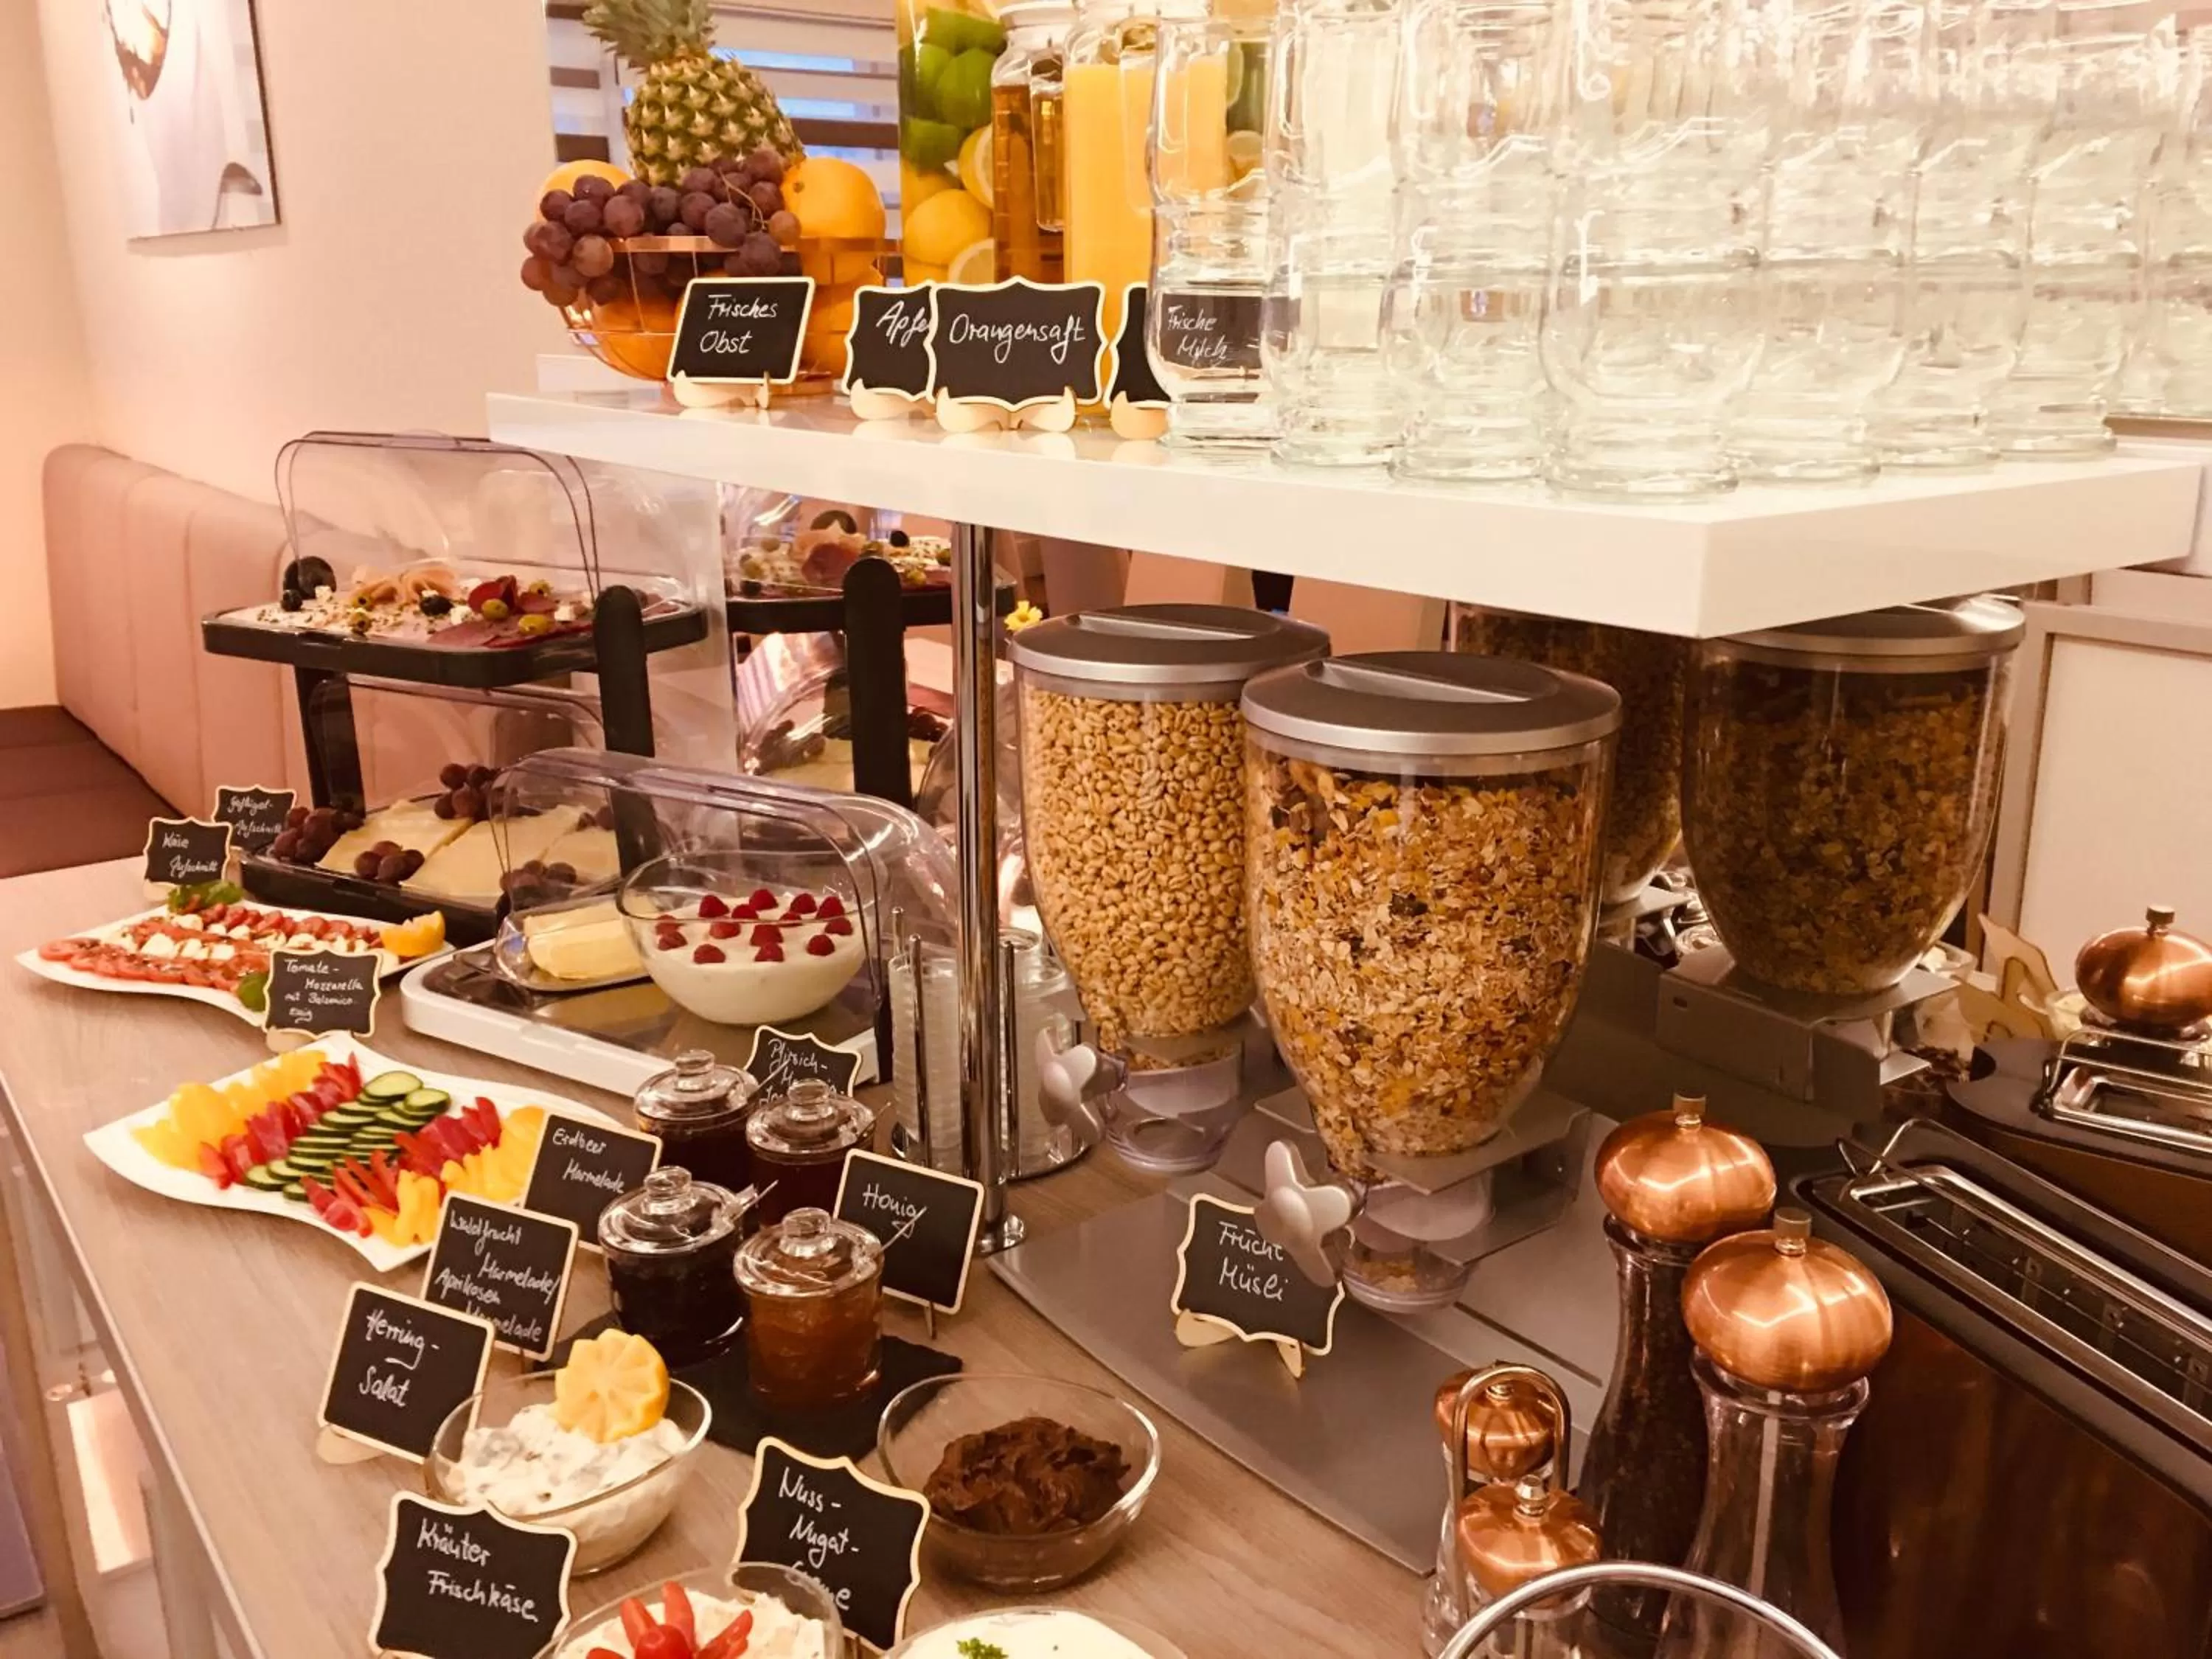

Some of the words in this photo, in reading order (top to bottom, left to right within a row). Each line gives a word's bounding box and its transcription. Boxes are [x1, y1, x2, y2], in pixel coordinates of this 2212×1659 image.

[708, 294, 778, 320] Frisches
[1167, 305, 1219, 331] Frische
[700, 330, 752, 354] Obst
[949, 313, 1086, 364] Orangensaft
[162, 832, 189, 849] Käse
[170, 854, 218, 878] Aufschnitt
[284, 992, 301, 1001] mit
[304, 977, 364, 992] Mozzarella
[552, 1127, 608, 1154] Erdbeer
[562, 1158, 625, 1194] Marmelade
[862, 1183, 917, 1239] Honig
[434, 1267, 501, 1305] Aprikosen
[1218, 1256, 1289, 1302] Müsli
[359, 1366, 411, 1408] Salat
[417, 1517, 492, 1566] Kräuter
[788, 1514, 860, 1569] Nugat-
[428, 1570, 539, 1623] Frischkäse
